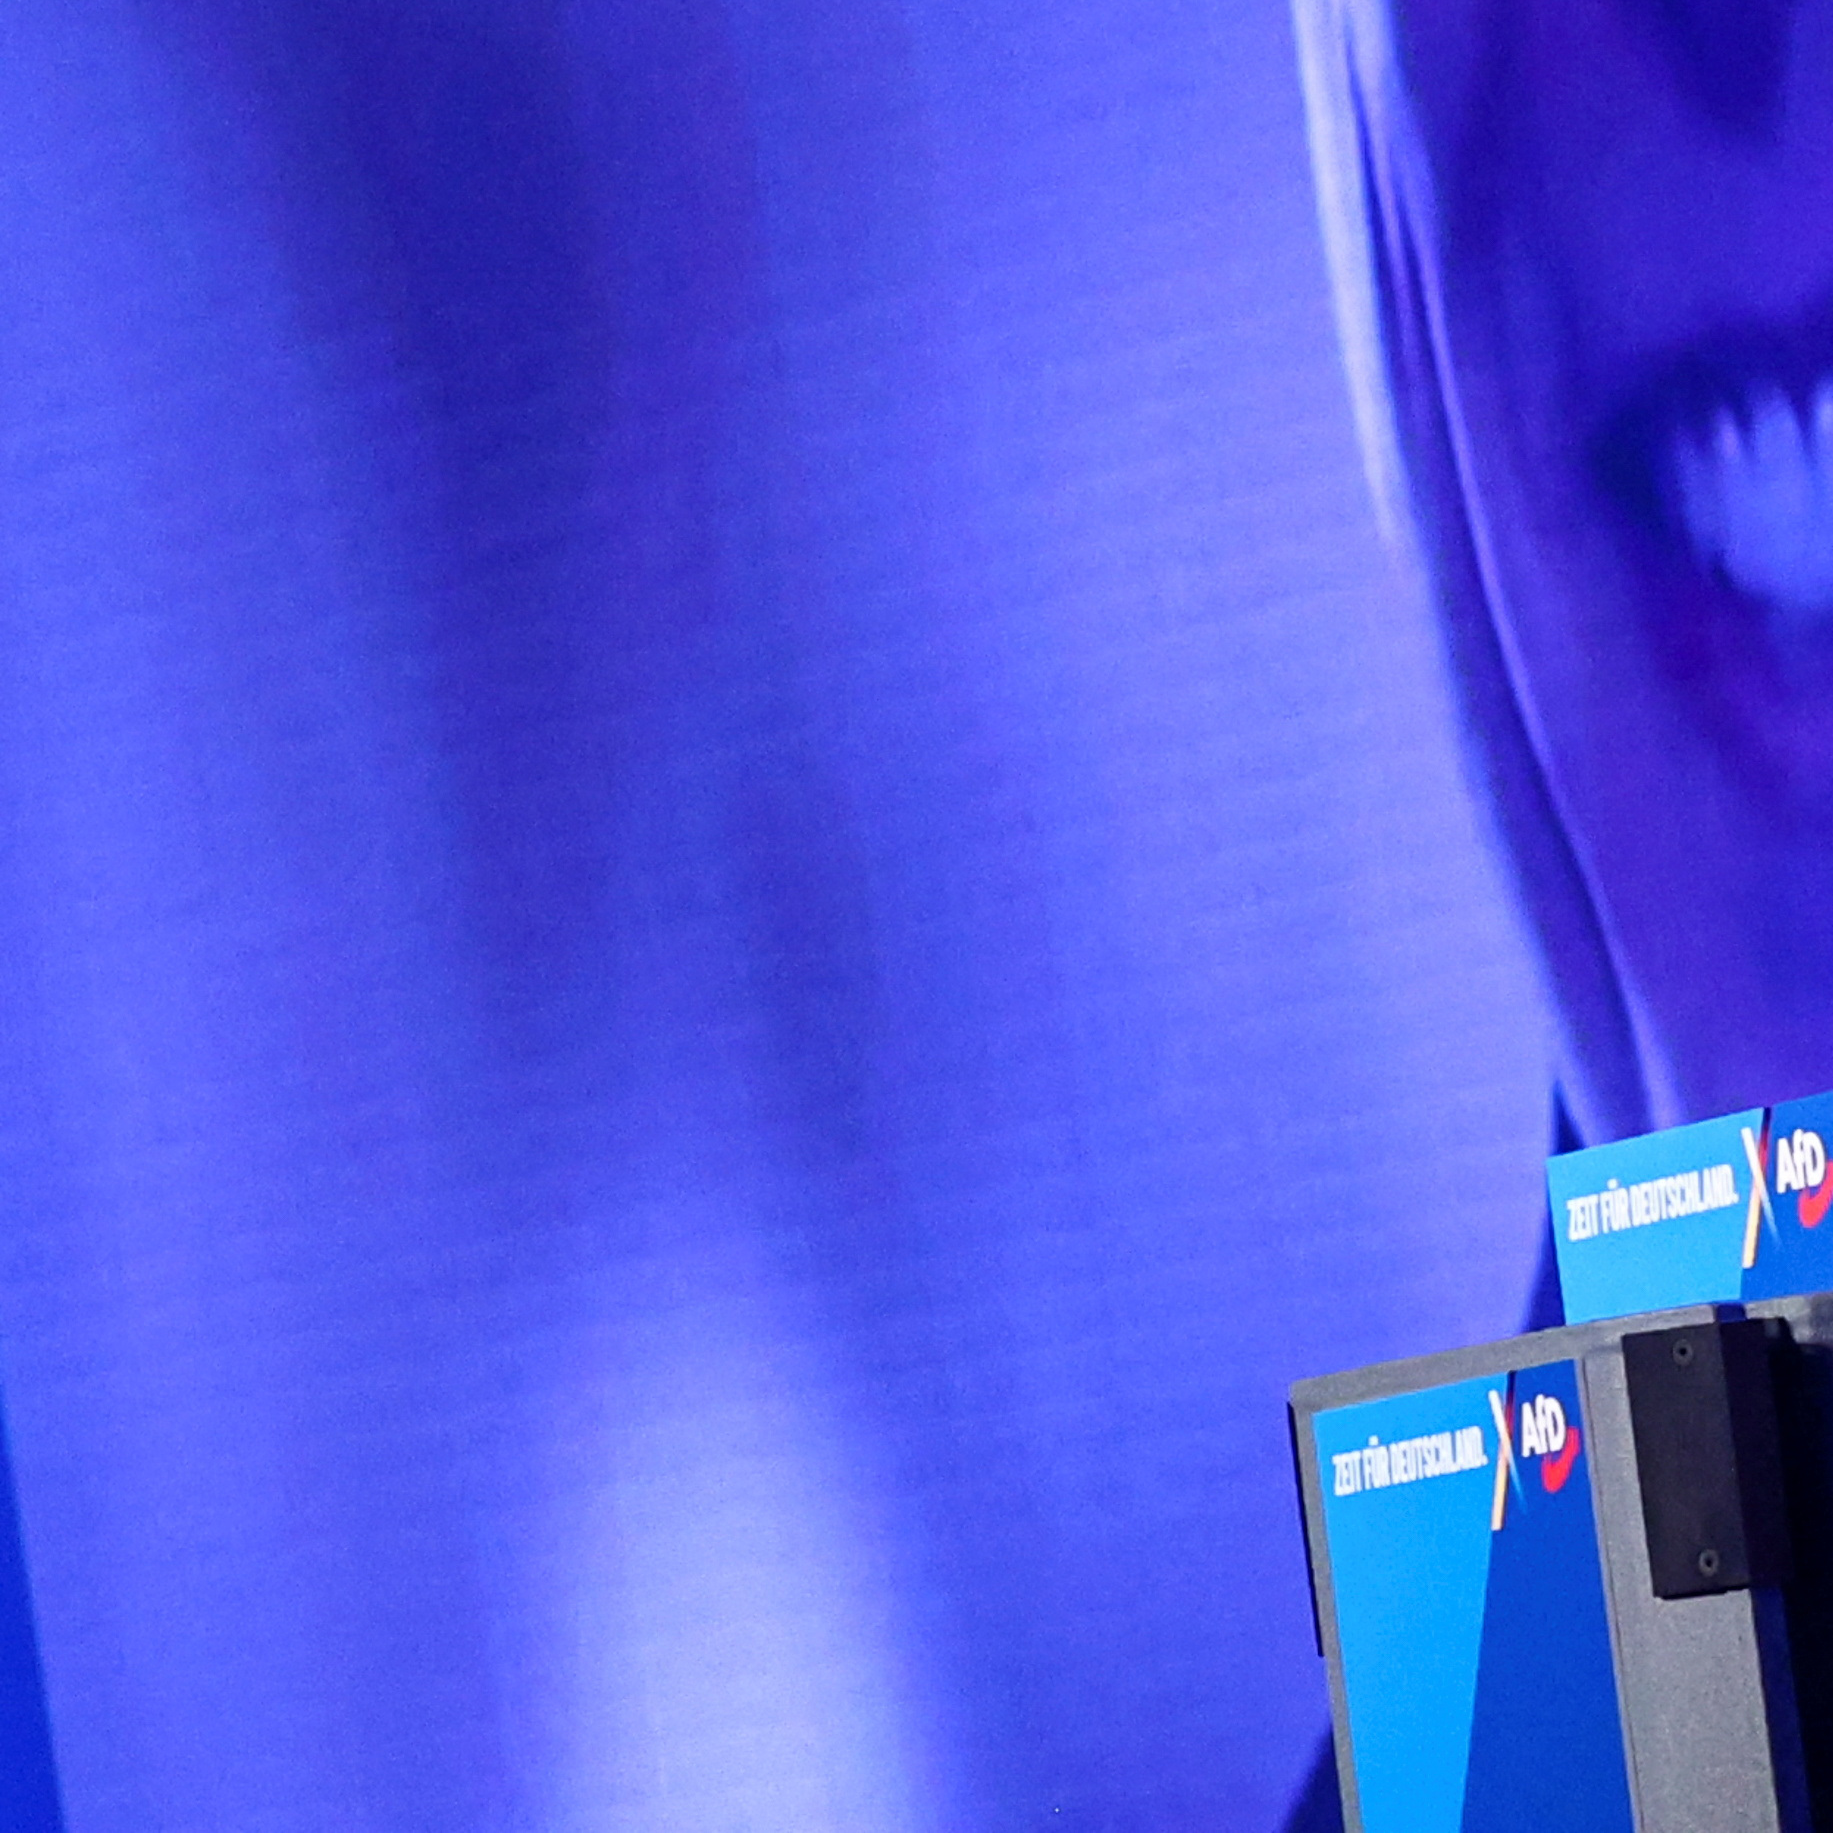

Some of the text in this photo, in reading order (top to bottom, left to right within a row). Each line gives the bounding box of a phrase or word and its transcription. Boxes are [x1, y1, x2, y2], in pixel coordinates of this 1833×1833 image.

[1775, 1128, 1826, 1194] AfD
[1567, 1164, 1740, 1242] ZEIT FÜR DEUTSCHLAND.
[1521, 1394, 1566, 1457] AfD
[1332, 1425, 1489, 1497] ZEIT FÜR DEUTSCHLAND.
